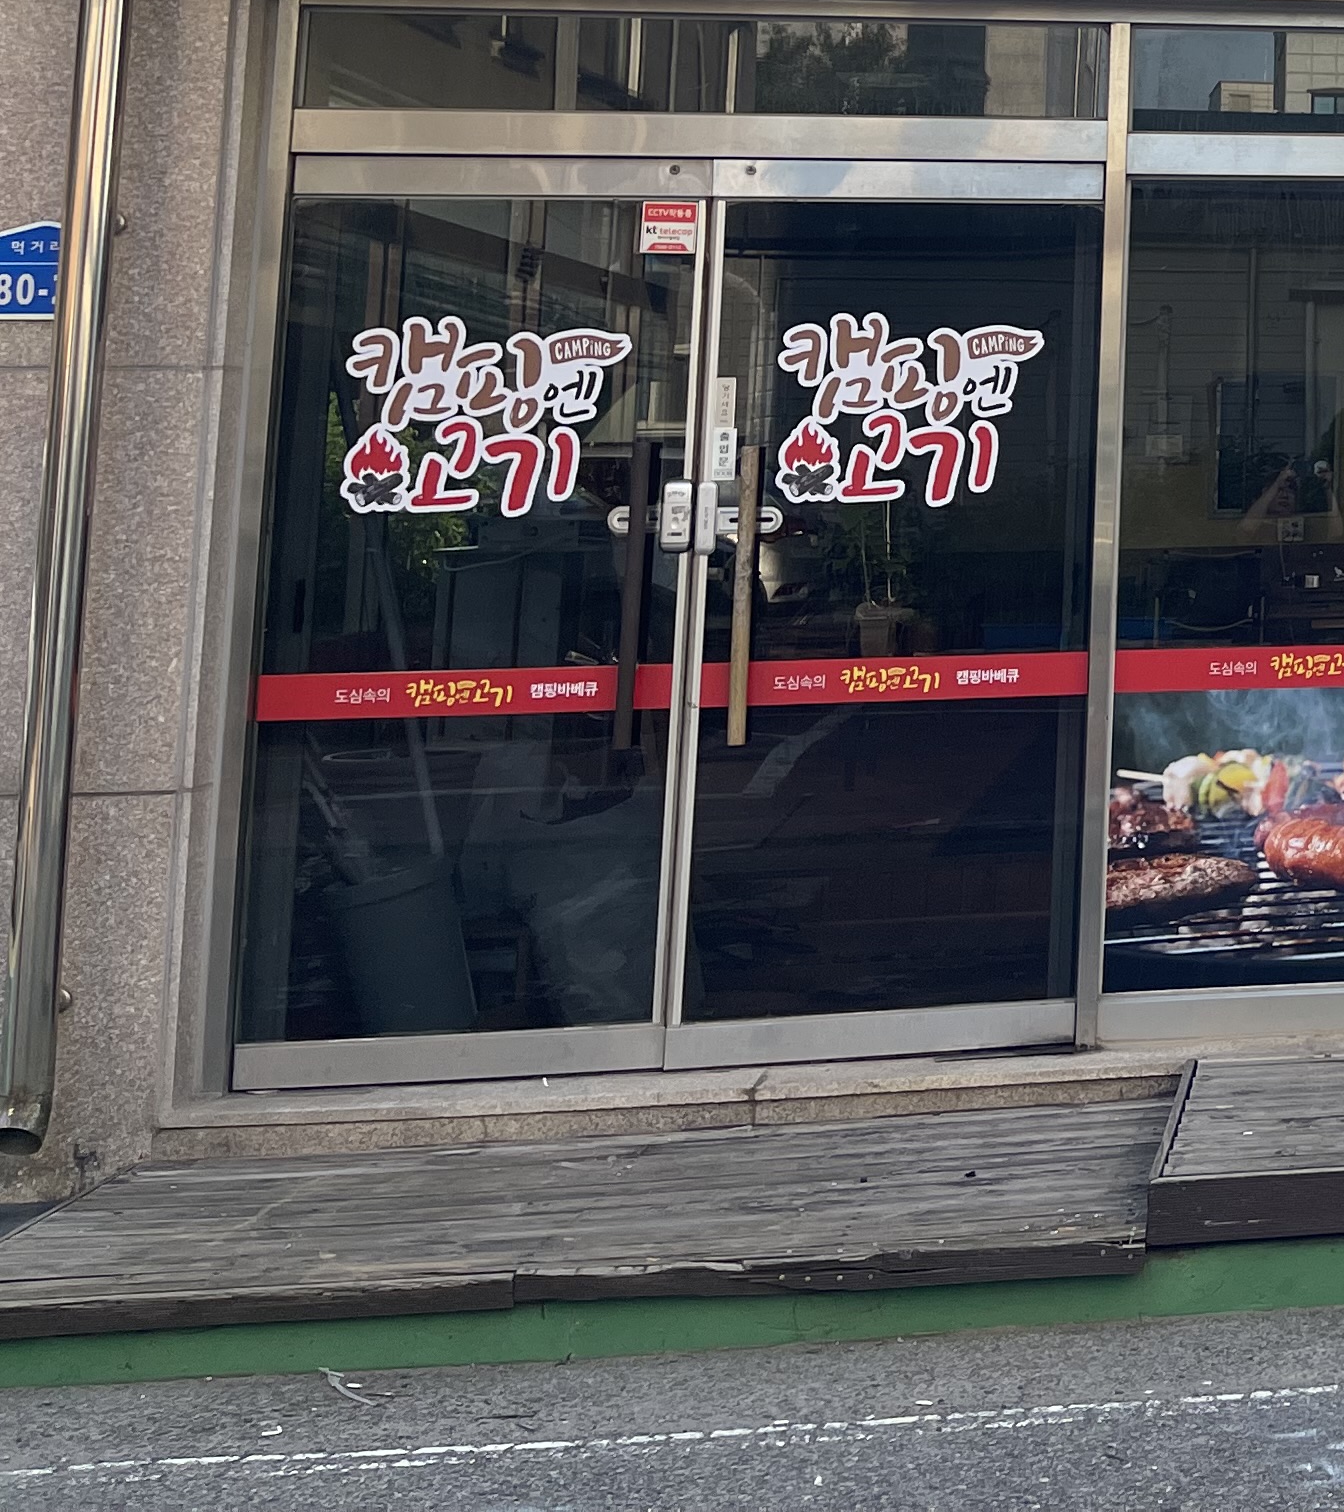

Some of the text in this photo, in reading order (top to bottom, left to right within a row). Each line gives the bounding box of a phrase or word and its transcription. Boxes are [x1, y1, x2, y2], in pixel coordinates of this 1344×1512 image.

[411, 421, 574, 511] 고기
[841, 414, 992, 501] 고기
[773, 674, 826, 691] 도심속의
[956, 668, 1020, 685] 캠핑바베큐
[1208, 661, 1257, 676] 도심속의
[334, 687, 391, 704] 도심속의
[530, 681, 598, 698] 캠핑바베큐
